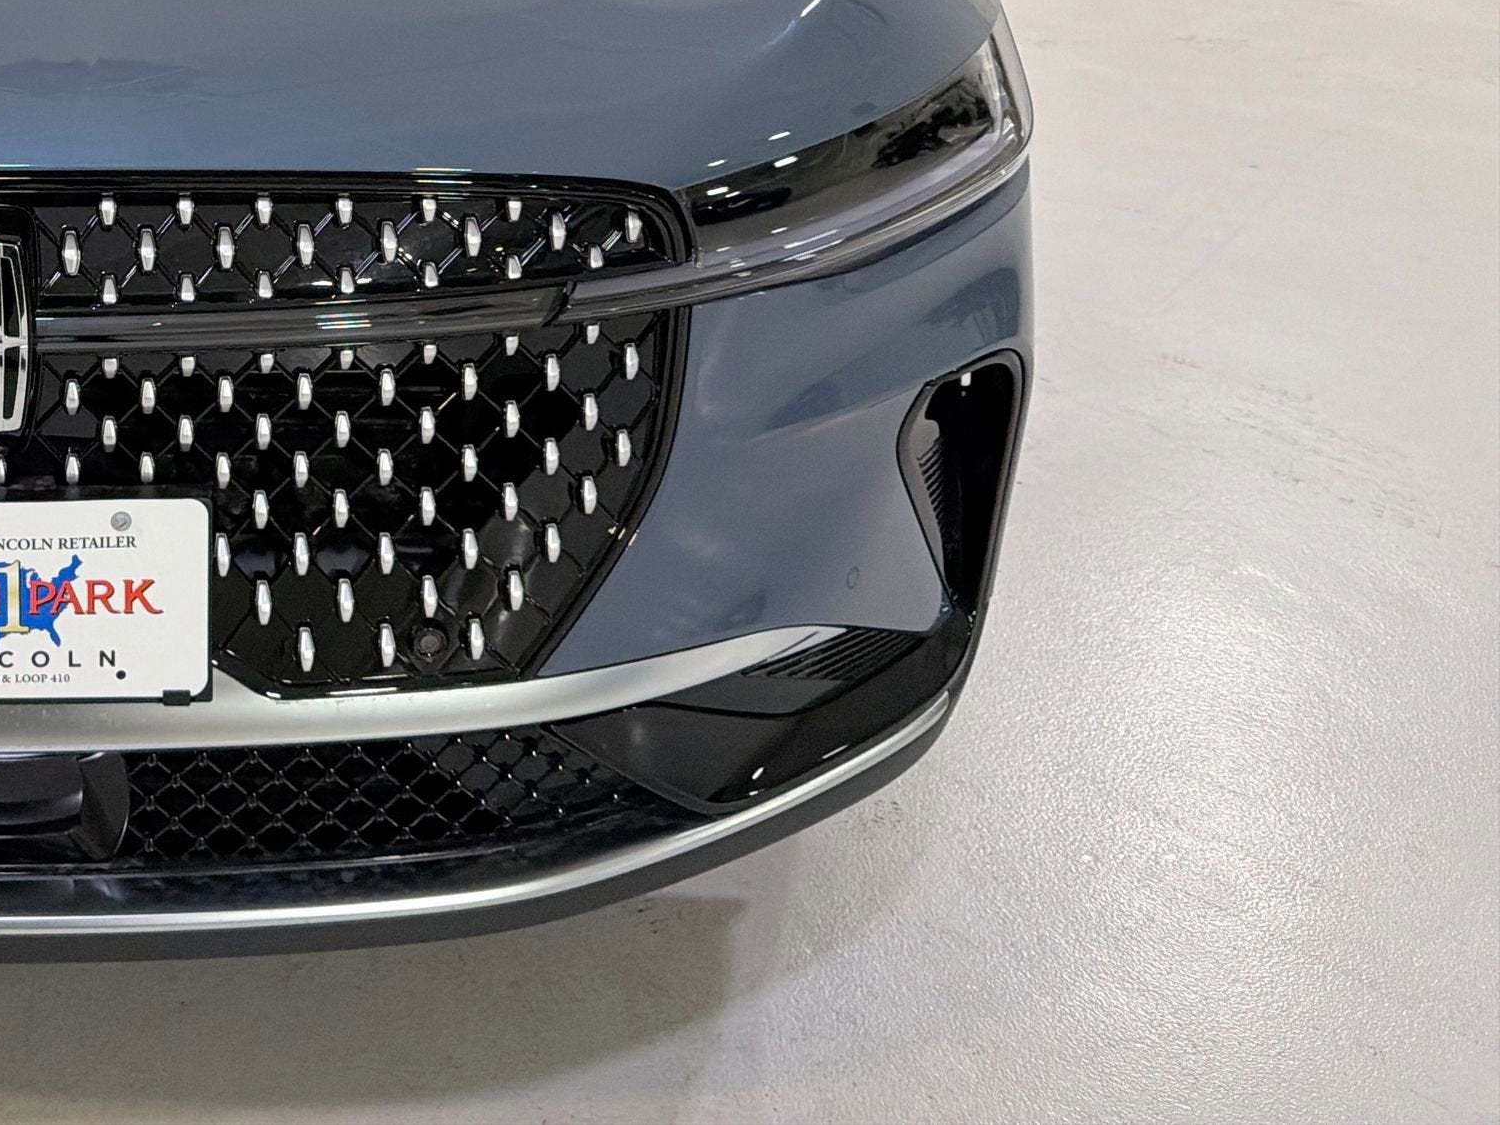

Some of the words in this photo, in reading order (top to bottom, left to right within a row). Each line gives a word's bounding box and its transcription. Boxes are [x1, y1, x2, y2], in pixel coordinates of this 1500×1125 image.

[58, 535, 138, 550] RETAILER
[28, 578, 164, 616] PARK
[1, 675, 11, 684] &
[15, 673, 48, 684] LOOP
[50, 673, 71, 683] 410
